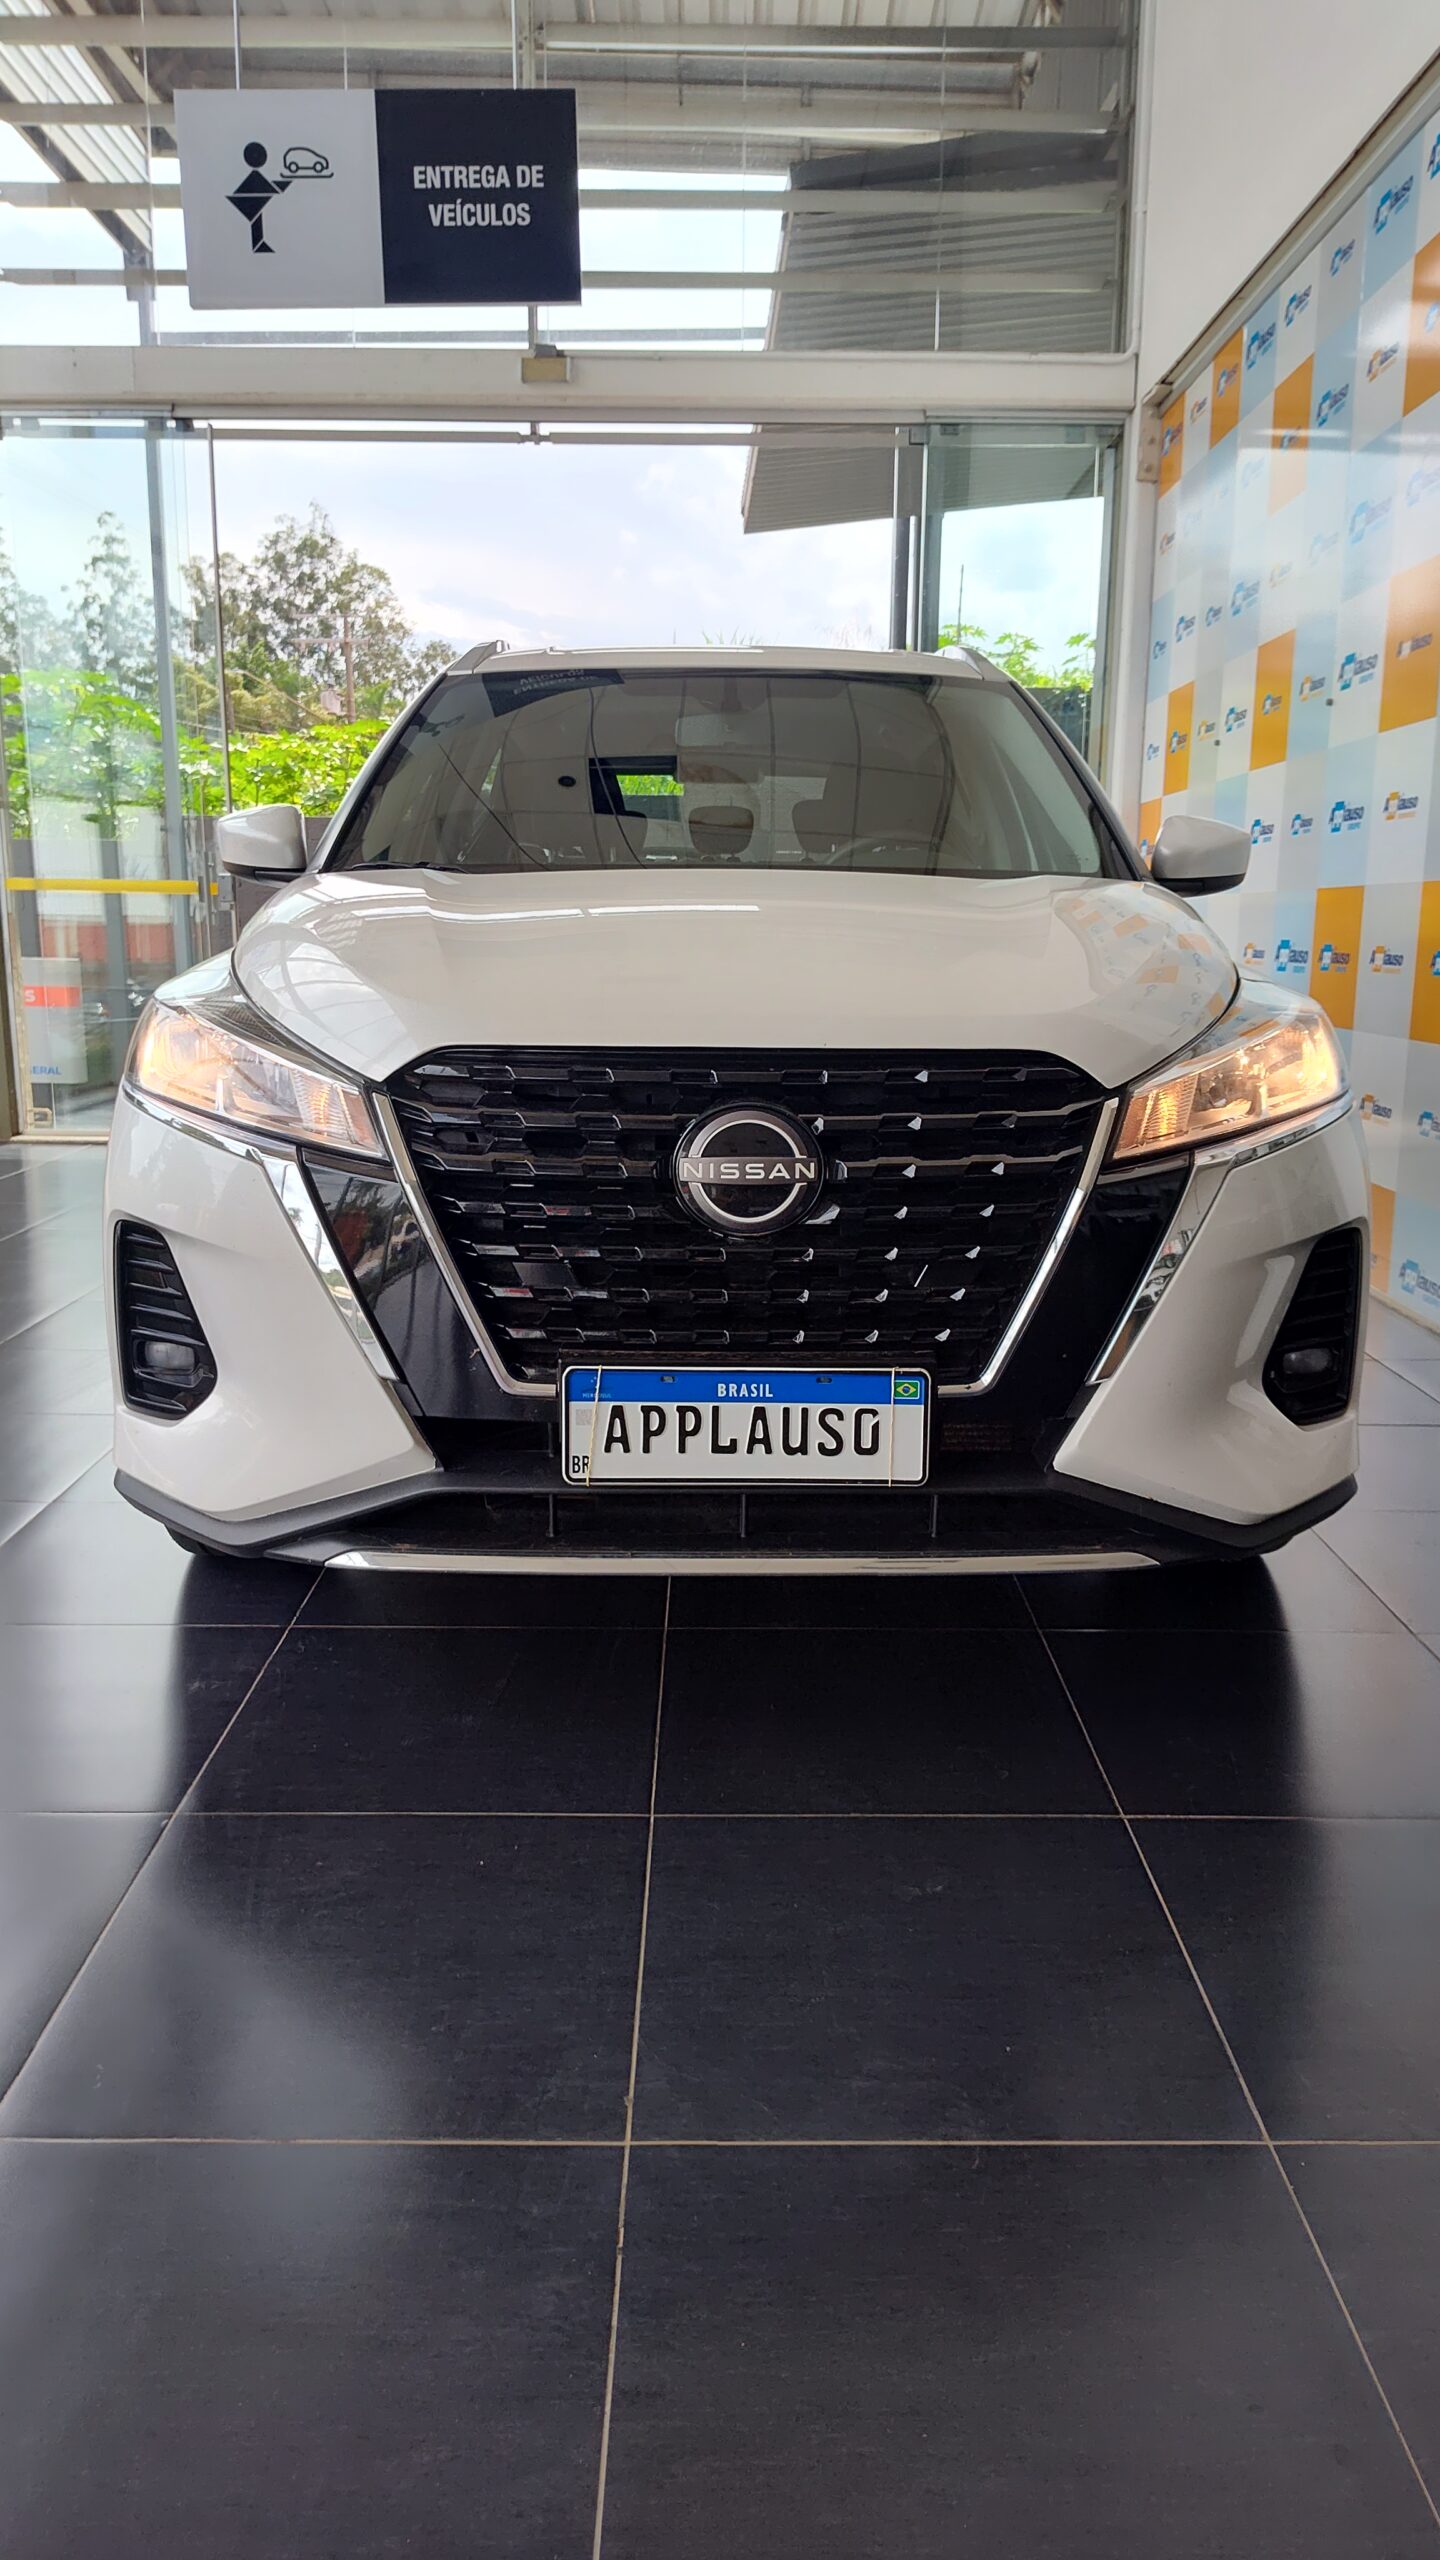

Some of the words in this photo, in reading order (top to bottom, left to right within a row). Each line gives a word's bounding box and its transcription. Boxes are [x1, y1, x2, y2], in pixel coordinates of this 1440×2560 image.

[413, 165, 511, 189] ENTREGA
[516, 165, 545, 188] DE
[428, 199, 531, 227] VEÍCULOS
[31, 1065, 62, 1075] ERAL
[683, 1162, 815, 1179] NISSAN
[717, 1383, 774, 1398] BRASIL
